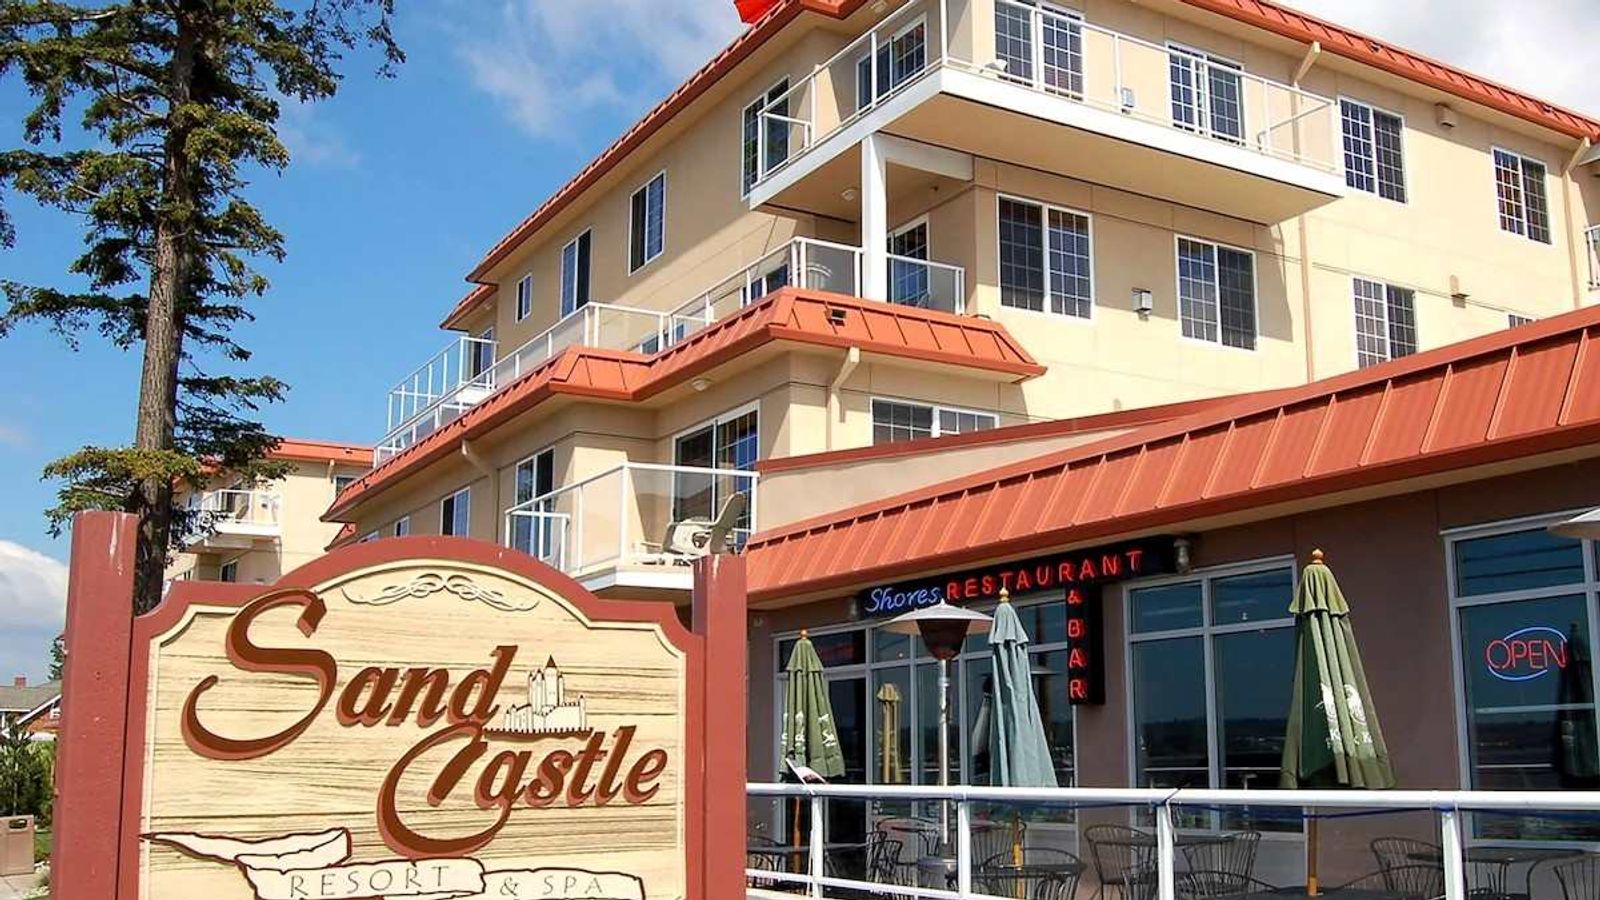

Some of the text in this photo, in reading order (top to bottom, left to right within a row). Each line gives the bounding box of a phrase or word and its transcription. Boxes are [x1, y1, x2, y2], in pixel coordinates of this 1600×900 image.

[865, 550, 1143, 613] Shores RESTAURANT
[181, 588, 518, 760] Sand
[1067, 589, 1087, 699] & BAR
[1486, 639, 1568, 671] OPEN
[376, 721, 668, 858] Castle
[289, 865, 604, 897] RESORT & SPA
